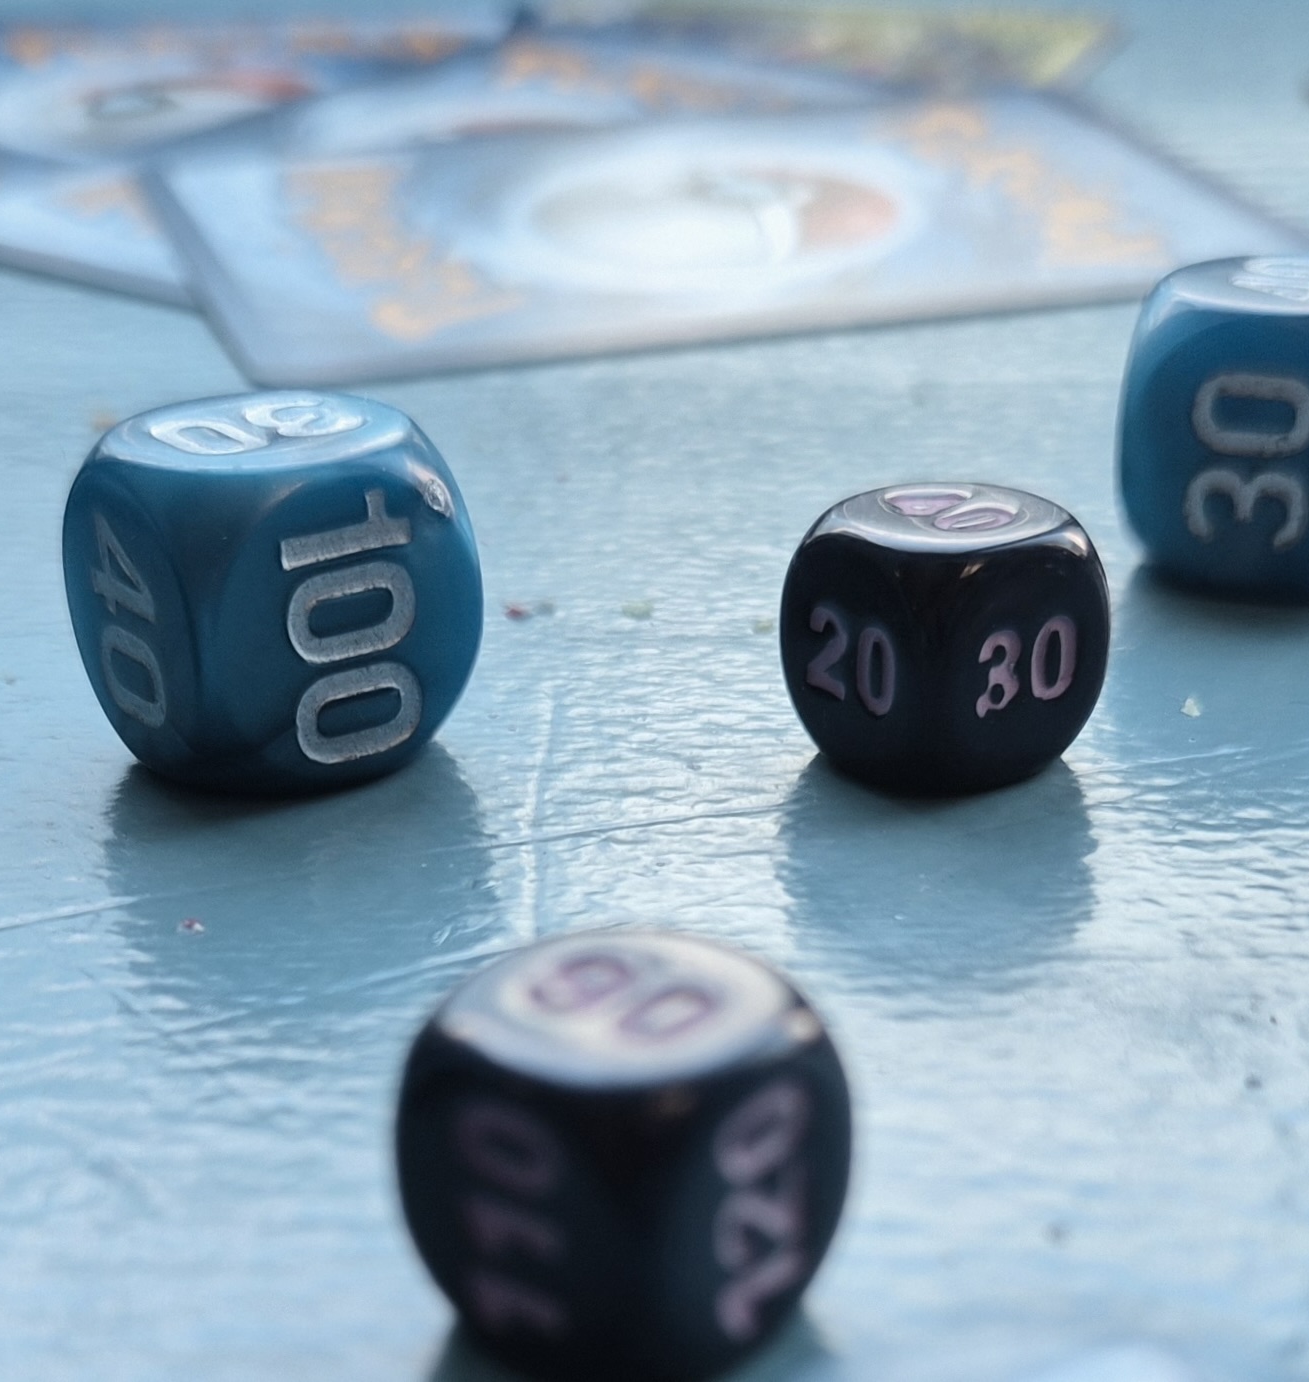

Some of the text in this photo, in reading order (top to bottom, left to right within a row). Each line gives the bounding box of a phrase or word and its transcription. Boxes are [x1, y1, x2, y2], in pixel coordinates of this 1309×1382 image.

[94, 511, 169, 731] 40
[279, 487, 423, 765] 100
[805, 605, 897, 718] 20
[974, 614, 1079, 720] 30
[454, 1103, 574, 1342] 110
[710, 1077, 809, 1342] 120
